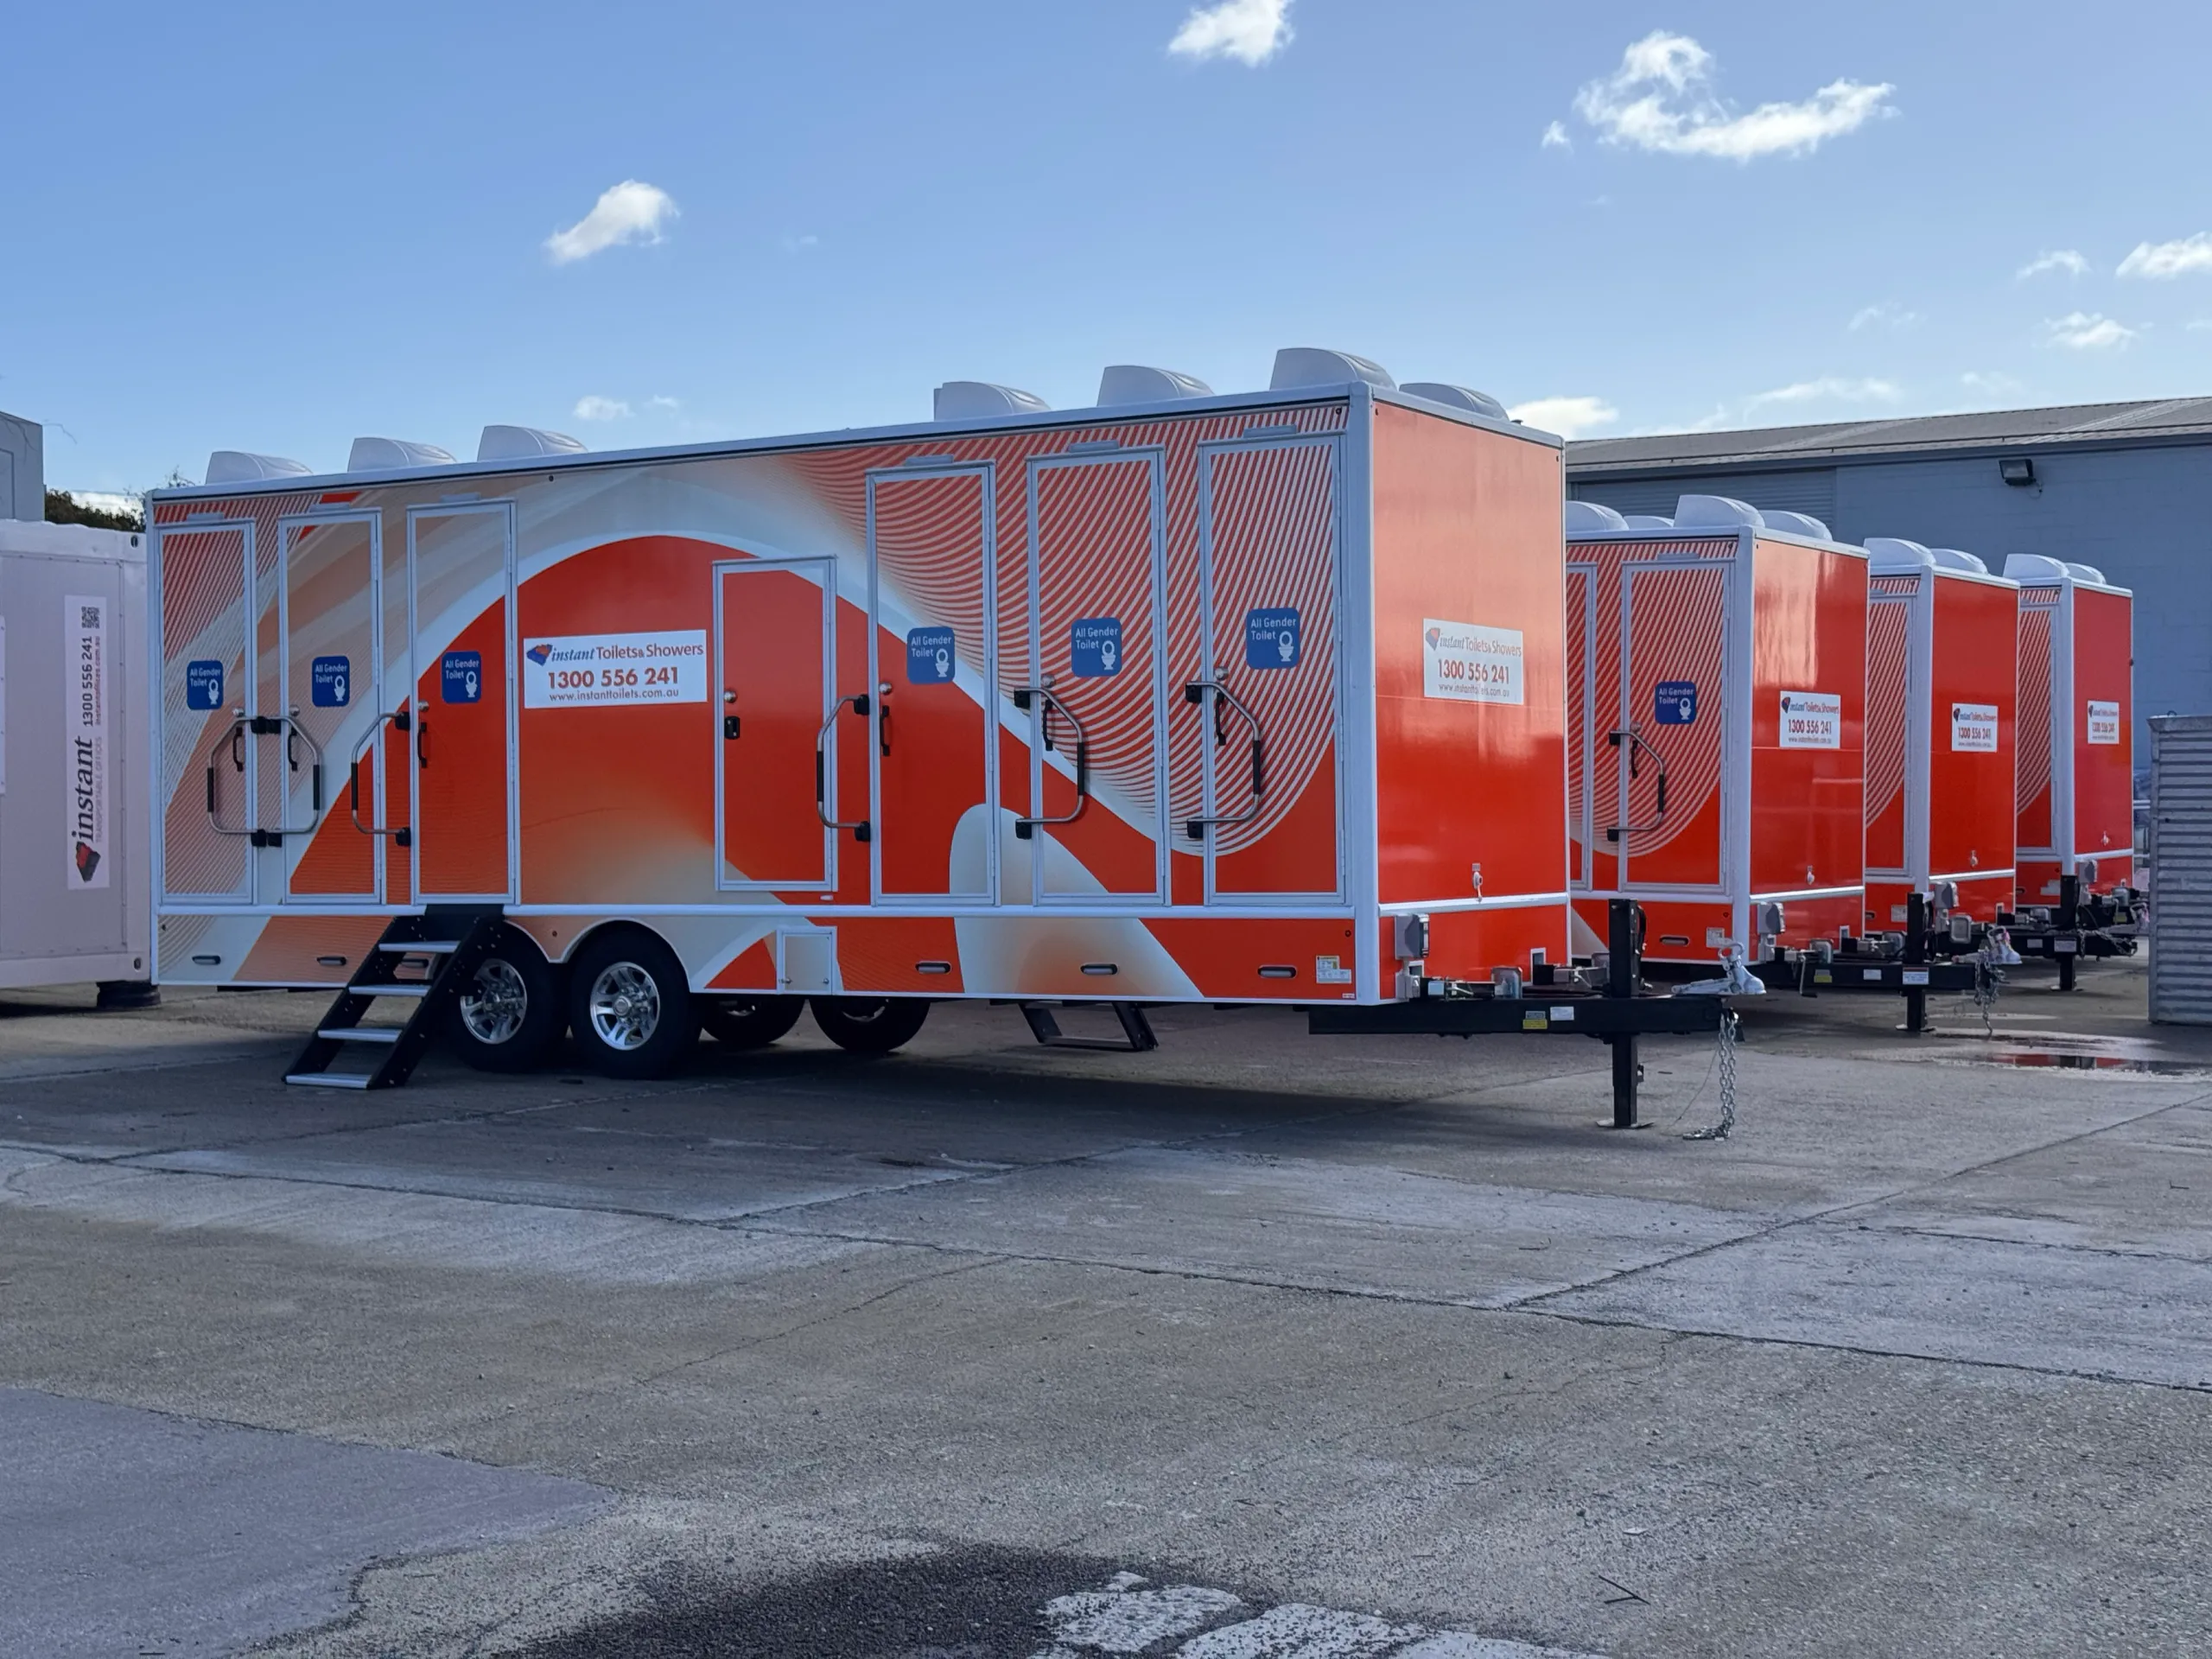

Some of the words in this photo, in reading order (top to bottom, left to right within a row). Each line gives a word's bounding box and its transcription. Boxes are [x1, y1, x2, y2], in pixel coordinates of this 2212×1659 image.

[1251, 618, 1262, 628] All
[1263, 616, 1296, 628] Gender
[1075, 627, 1086, 639] All
[1087, 626, 1119, 638] Gender
[1251, 630, 1276, 640] Toilet
[912, 636, 921, 646] All
[922, 635, 951, 645] Gender
[1075, 639, 1099, 650] Toilet
[1440, 632, 1465, 650] instant
[1491, 640, 1522, 658] Showers
[81, 636, 92, 661] 241
[551, 647, 595, 663] instant
[645, 643, 704, 658] Showers
[912, 647, 933, 657] Toilet
[324, 664, 347, 673] Gender
[445, 659, 454, 669] All
[454, 658, 480, 668] Gender
[81, 664, 92, 689] 556
[199, 667, 221, 677] Gender
[445, 670, 465, 679] Toilet
[1438, 658, 1465, 680] 1300
[1468, 662, 1488, 682] 556
[1491, 664, 1510, 684] 241
[190, 677, 207, 688] Toilet
[315, 674, 334, 683] Toilet
[548, 670, 594, 690] 1300
[601, 668, 639, 687] 556
[645, 666, 678, 685] 241
[550, 688, 679, 702] www.instanttoilets.com.au
[1668, 687, 1694, 696] Gender
[1659, 696, 1678, 705] Toilet
[82, 693, 93, 727] 1300
[1788, 718, 1805, 734] 1300
[1807, 719, 1820, 734] 556
[1821, 720, 1832, 734] 241
[72, 735, 94, 842] instant
